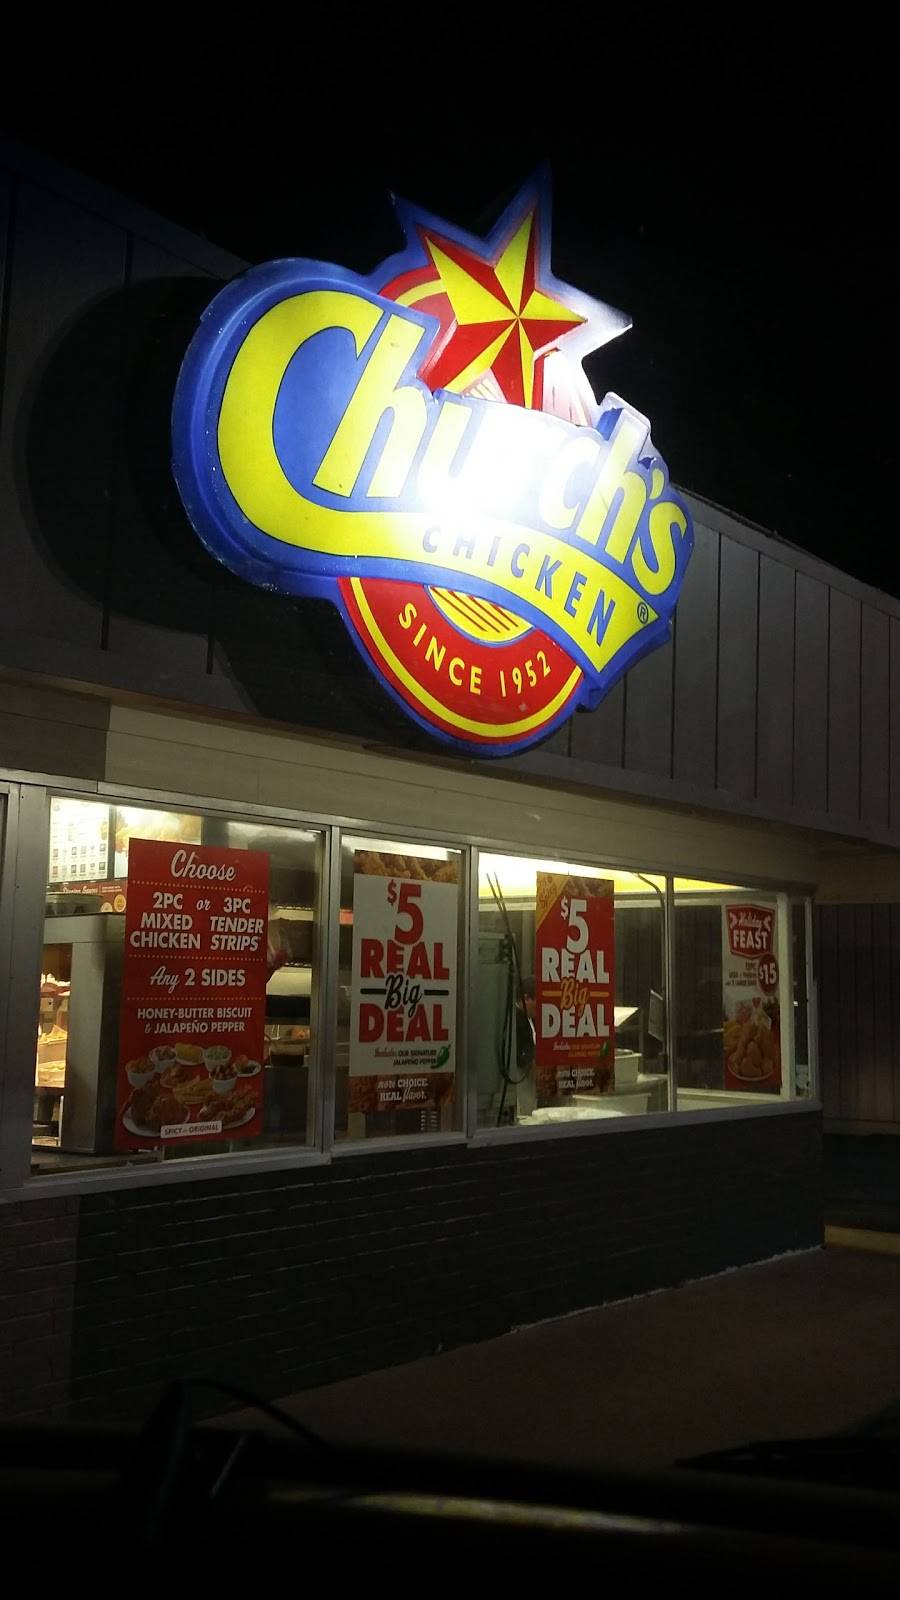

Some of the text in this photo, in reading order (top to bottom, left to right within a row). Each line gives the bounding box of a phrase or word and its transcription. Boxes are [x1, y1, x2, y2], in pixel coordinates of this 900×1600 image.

[217, 290, 687, 595] Chuch's
[422, 525, 616, 647] CHICKEN
[398, 602, 552, 698] SINCE 1952
[170, 849, 236, 881] Choose
[152, 892, 251, 914] 2PC or 3PC
[386, 879, 424, 946] $5
[140, 912, 265, 934] MIXED TENDER
[560, 896, 589, 953] $5
[733, 930, 768, 950] FEAST
[129, 931, 260, 952] CHICKEN STRIPS
[360, 938, 450, 980] REAL
[150, 965, 246, 994] Any 2 SIDES
[541, 948, 610, 984] REAL
[759, 963, 777, 985] $15
[137, 1007, 253, 1020] HONEY-BUTTER BISCUIT
[384, 974, 423, 1018] Big
[560, 977, 591, 1016] Big
[153, 1019, 209, 1034] JALAPEÑO
[210, 1021, 246, 1033] PEPPER
[358, 1003, 449, 1043] DEAL
[541, 1003, 610, 1039] DEAL
